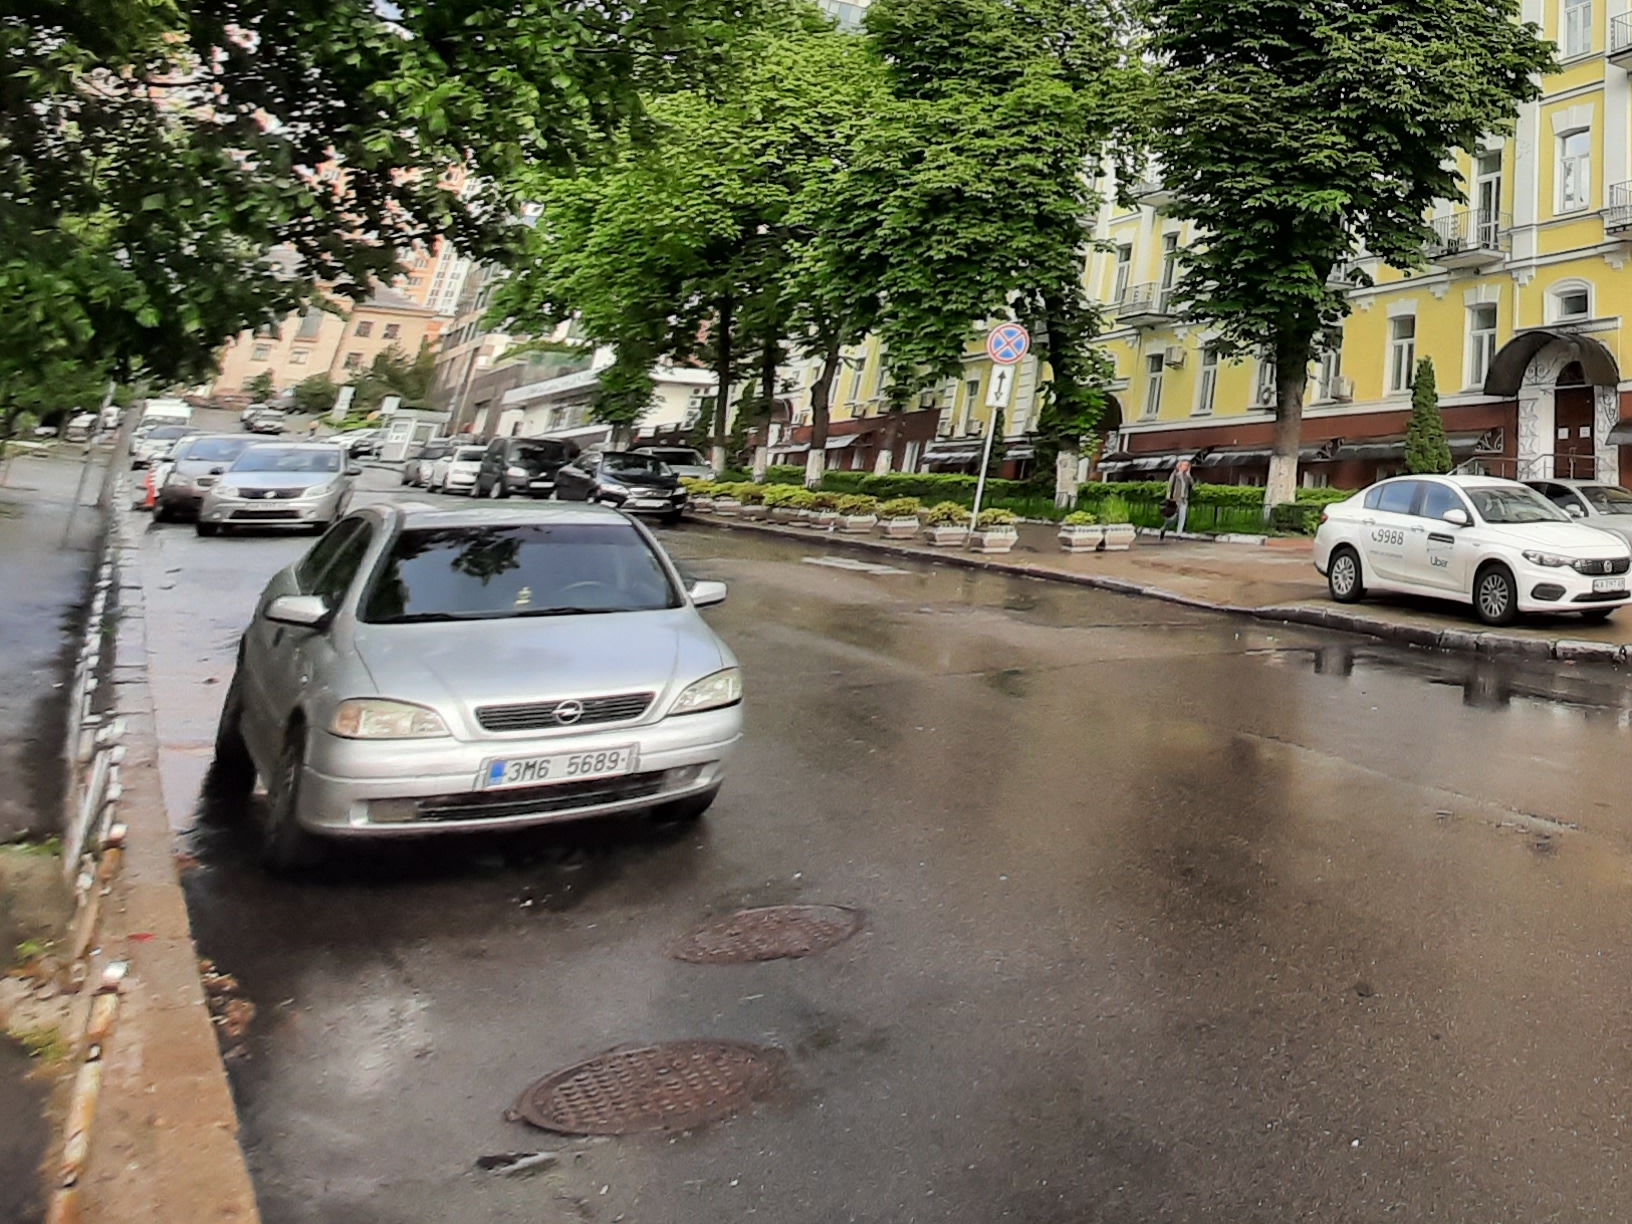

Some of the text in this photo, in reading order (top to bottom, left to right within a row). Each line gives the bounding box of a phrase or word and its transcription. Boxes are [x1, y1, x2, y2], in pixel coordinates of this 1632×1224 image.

[1377, 528, 1404, 546] 9988
[1430, 555, 1448, 568] Uber
[508, 751, 620, 782] 3M6 5689
